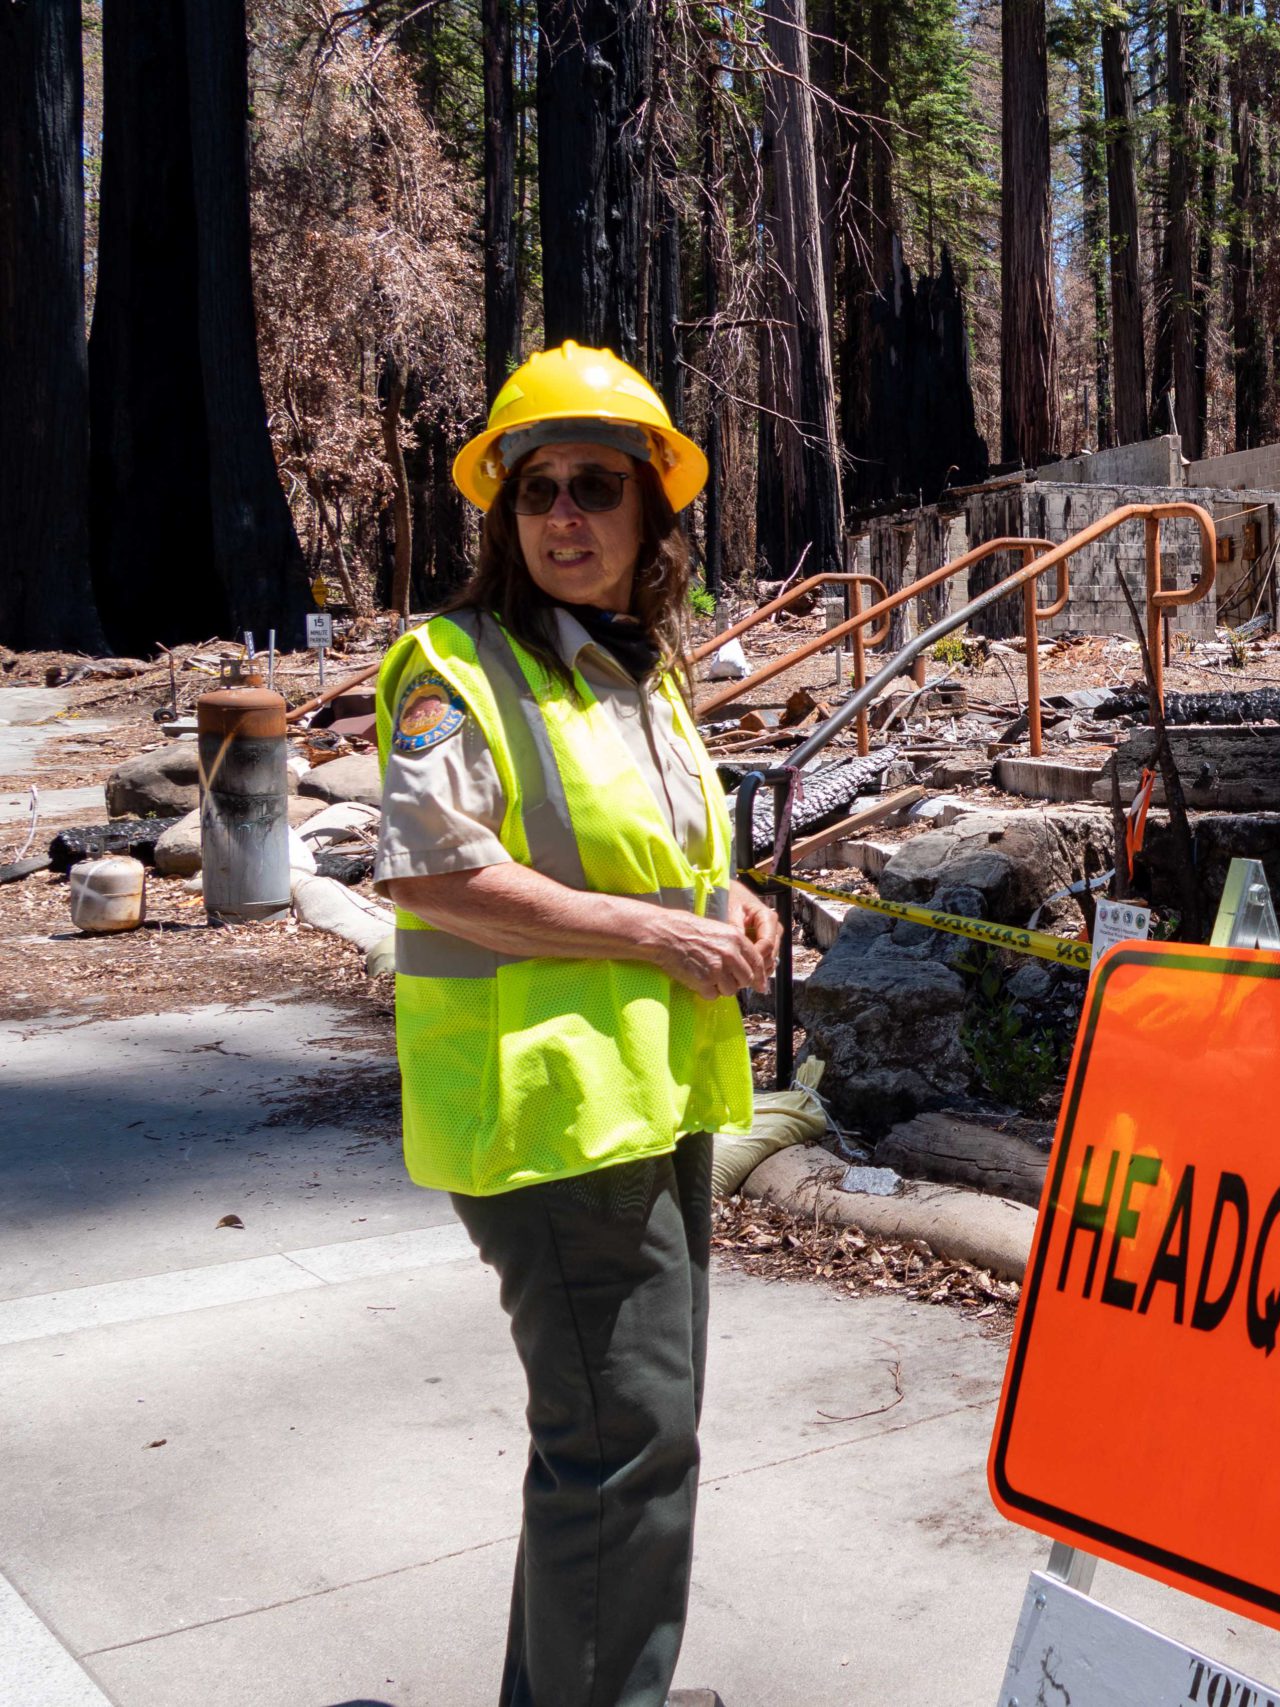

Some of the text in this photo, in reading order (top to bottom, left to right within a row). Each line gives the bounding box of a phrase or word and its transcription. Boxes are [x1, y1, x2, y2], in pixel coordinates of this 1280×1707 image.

[314, 618, 325, 628] 15
[424, 709, 462, 744] PARKS
[1187, 1658, 1276, 1707] TOT
